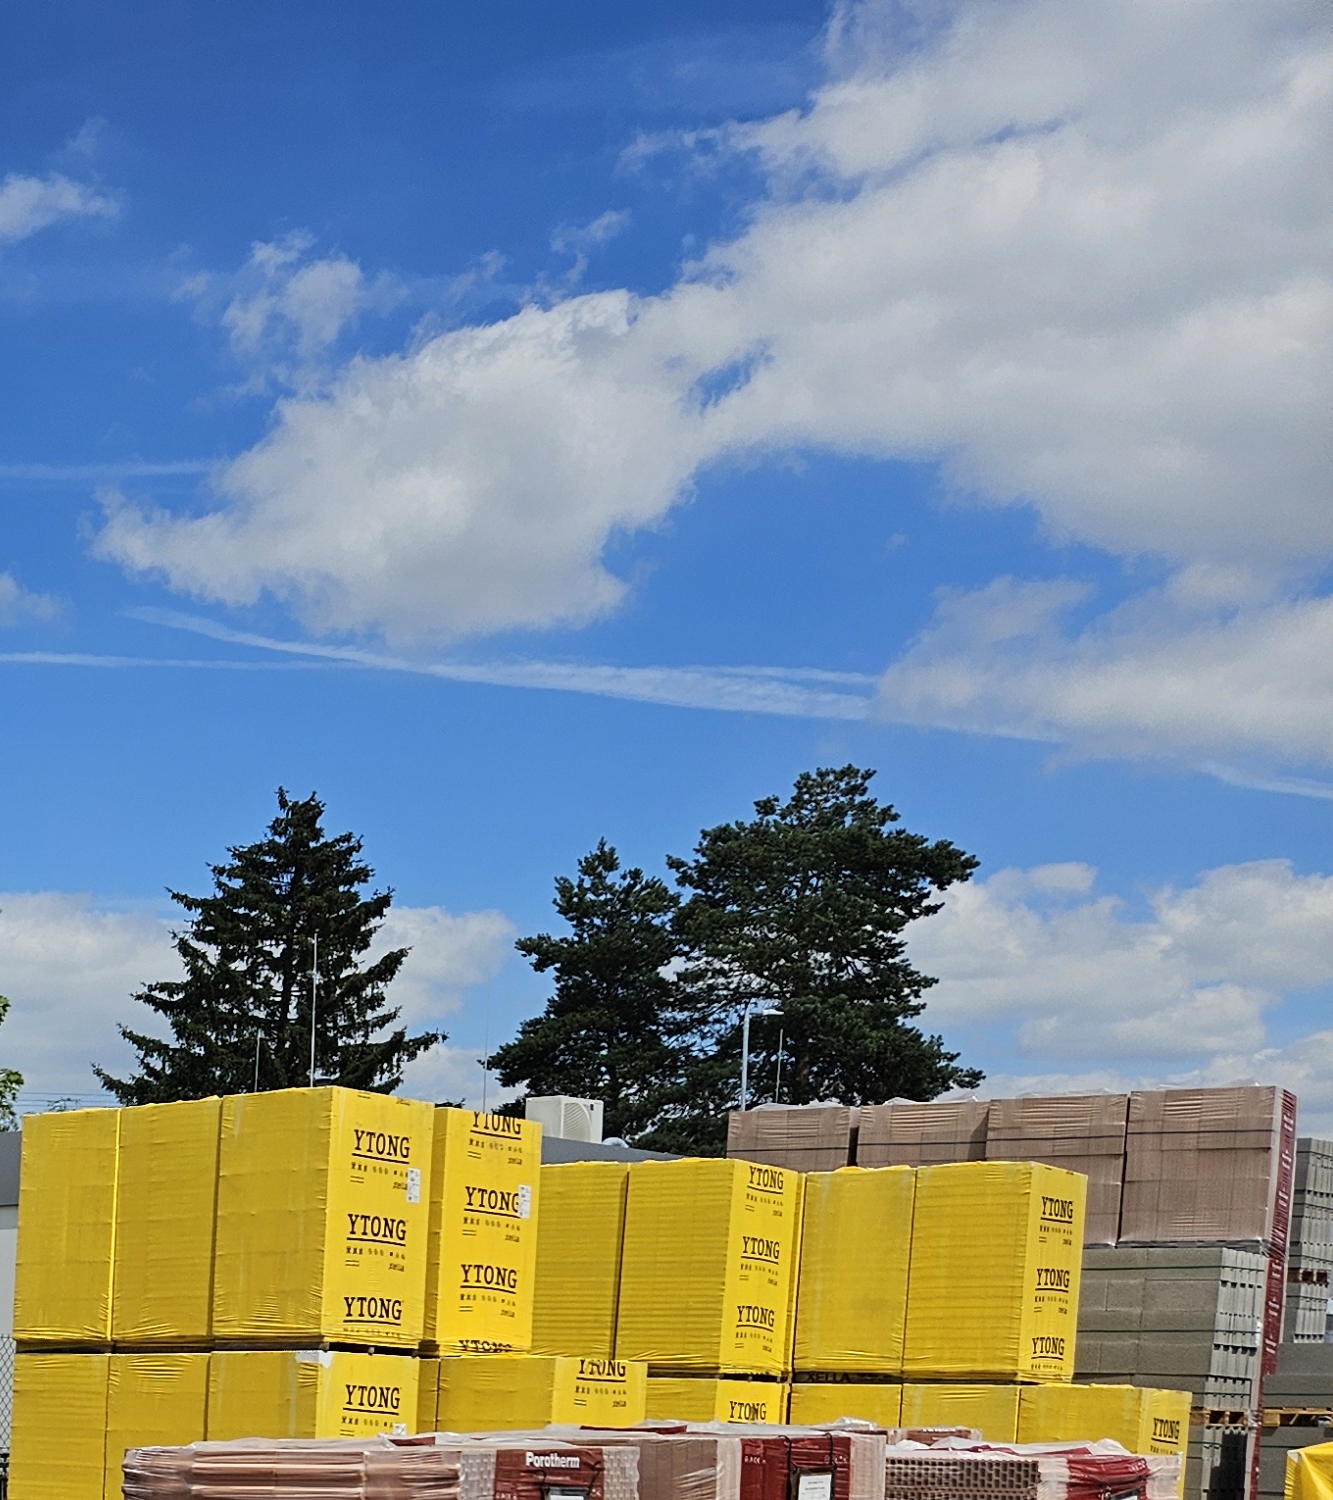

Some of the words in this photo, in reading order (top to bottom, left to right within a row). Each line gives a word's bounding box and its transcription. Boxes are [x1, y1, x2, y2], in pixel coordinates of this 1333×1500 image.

[354, 1129, 410, 1158] YTONG
[749, 1166, 783, 1190] YTONG
[465, 1186, 519, 1213] YTONG
[1041, 1196, 1073, 1219] YTONG
[348, 1213, 406, 1241] YTONG
[742, 1236, 779, 1260] YTONG
[461, 1264, 517, 1288] YTONG
[1037, 1268, 1069, 1288] YTONG
[344, 1296, 402, 1320] YTONG
[737, 1305, 774, 1327] YTONG
[1032, 1337, 1065, 1356] YTONG
[345, 1384, 400, 1409] YTONG
[729, 1400, 767, 1420] YTONG
[1153, 1417, 1180, 1439] YTONG
[525, 1452, 580, 1468] Porotherm
